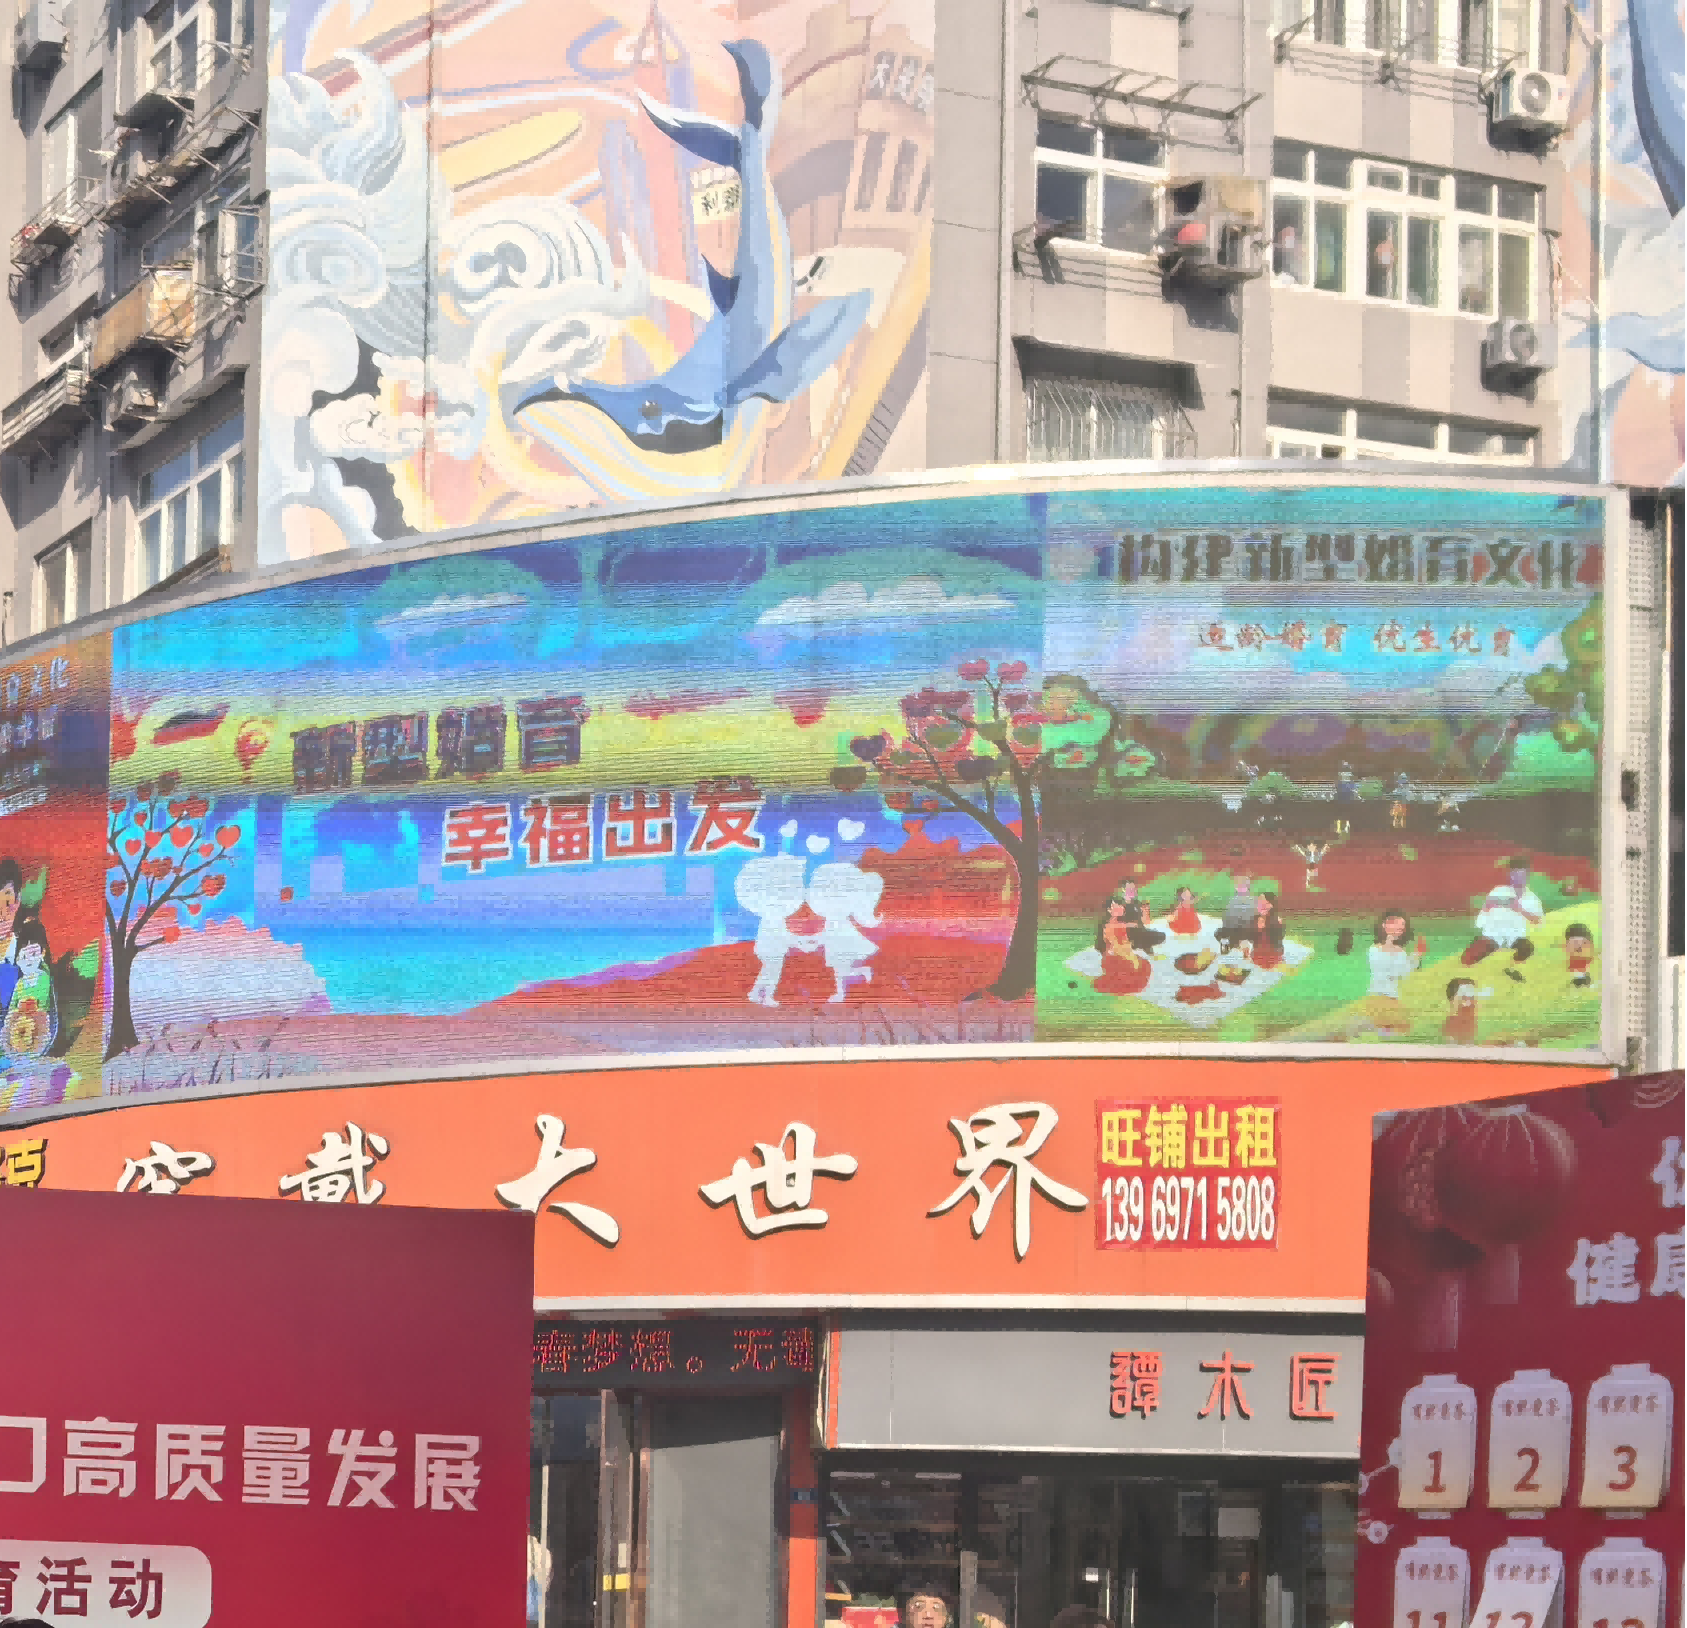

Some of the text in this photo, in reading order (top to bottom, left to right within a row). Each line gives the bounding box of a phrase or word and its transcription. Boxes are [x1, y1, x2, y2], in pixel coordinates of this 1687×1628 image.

[440, 776, 765, 874] 幸福出发
[1100, 1103, 1278, 1169] 旺铺出租
[1101, 1175, 1276, 1242] 139 6971 5808
[1422, 1450, 1446, 1493] 1
[1514, 1447, 1540, 1492] 2
[1608, 1445, 1638, 1491] 3
